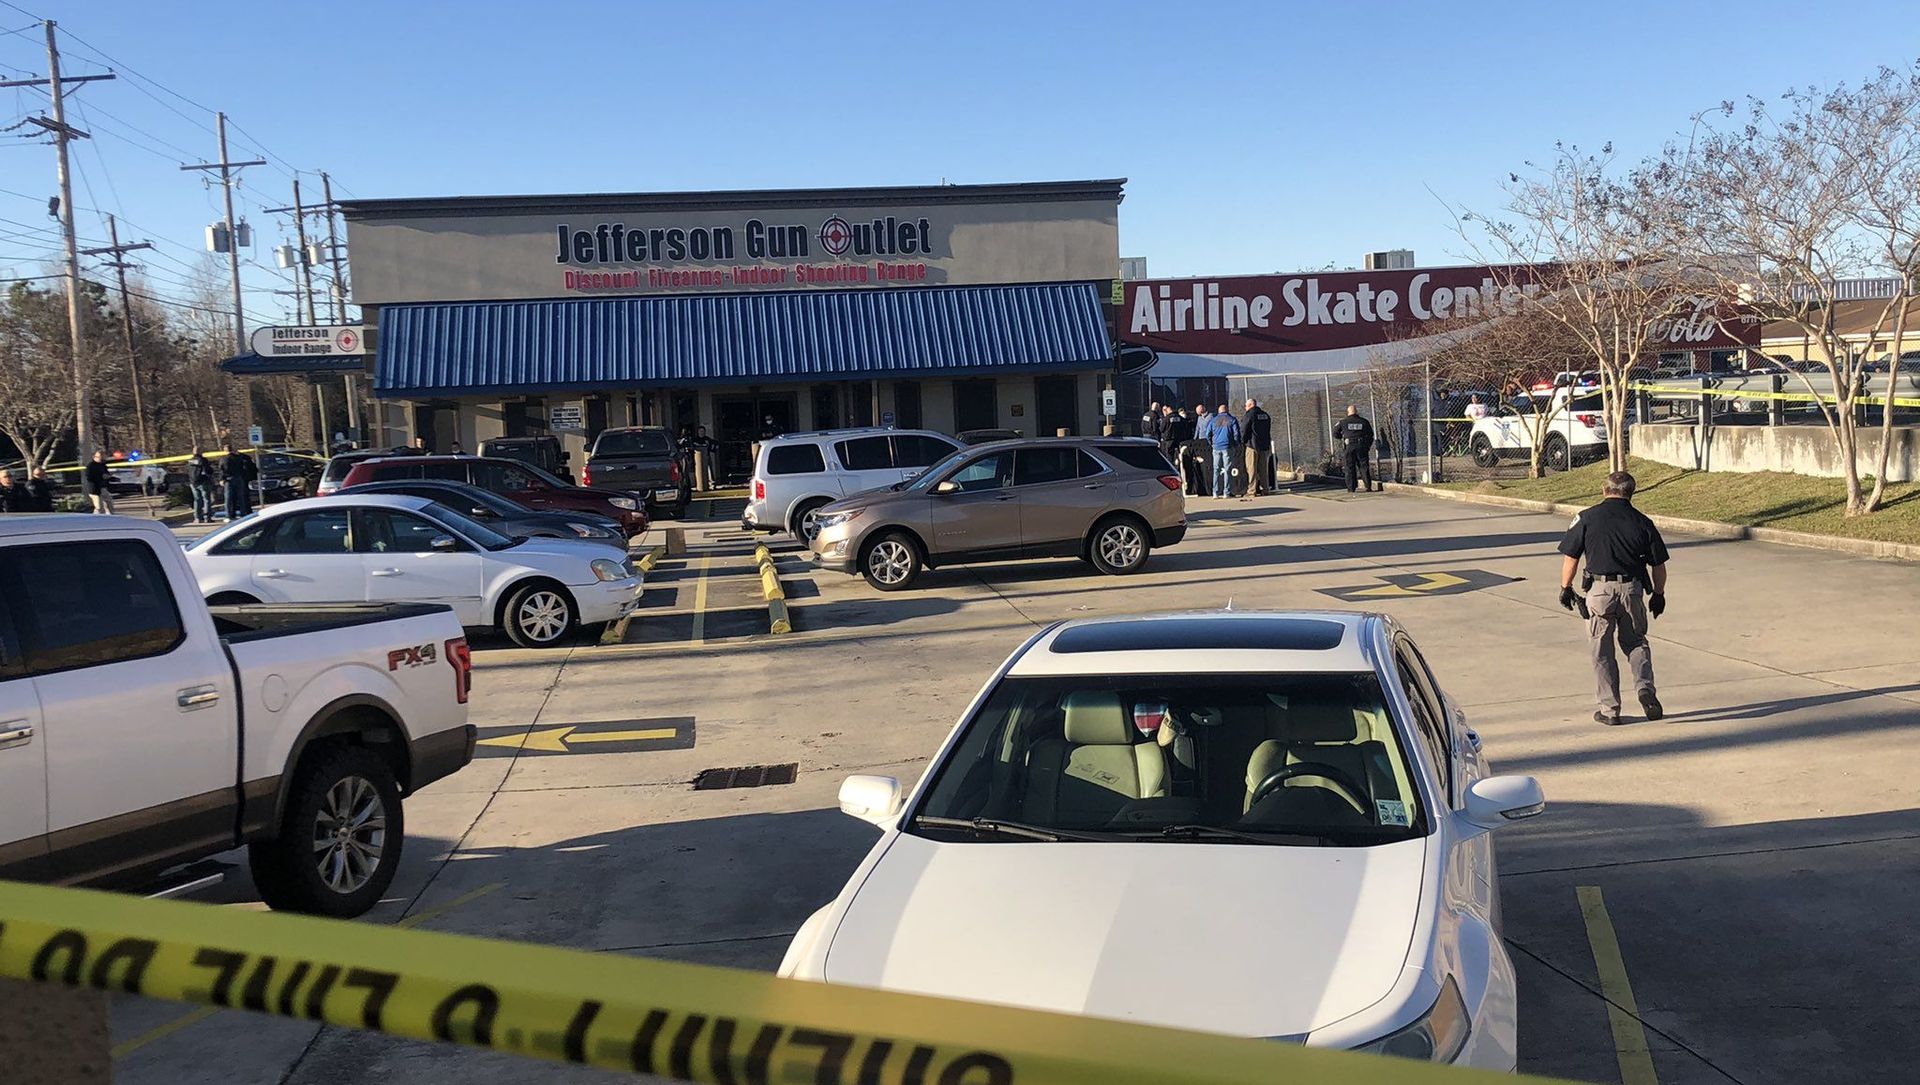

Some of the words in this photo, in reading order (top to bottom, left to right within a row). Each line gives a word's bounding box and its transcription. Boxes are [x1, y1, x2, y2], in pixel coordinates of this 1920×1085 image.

[556, 223, 735, 264] Jefferson
[745, 218, 809, 259] Gun
[564, 270, 641, 290] Discount
[795, 262, 868, 283] Shooting
[876, 260, 926, 281] Range
[1131, 282, 1273, 334] Airline
[1282, 278, 1399, 327] Skate
[1408, 273, 1541, 322] Center
[272, 328, 329, 339] Jefferson
[272, 343, 302, 354] Indoor
[304, 343, 332, 355] Range
[388, 643, 436, 672] FX4
